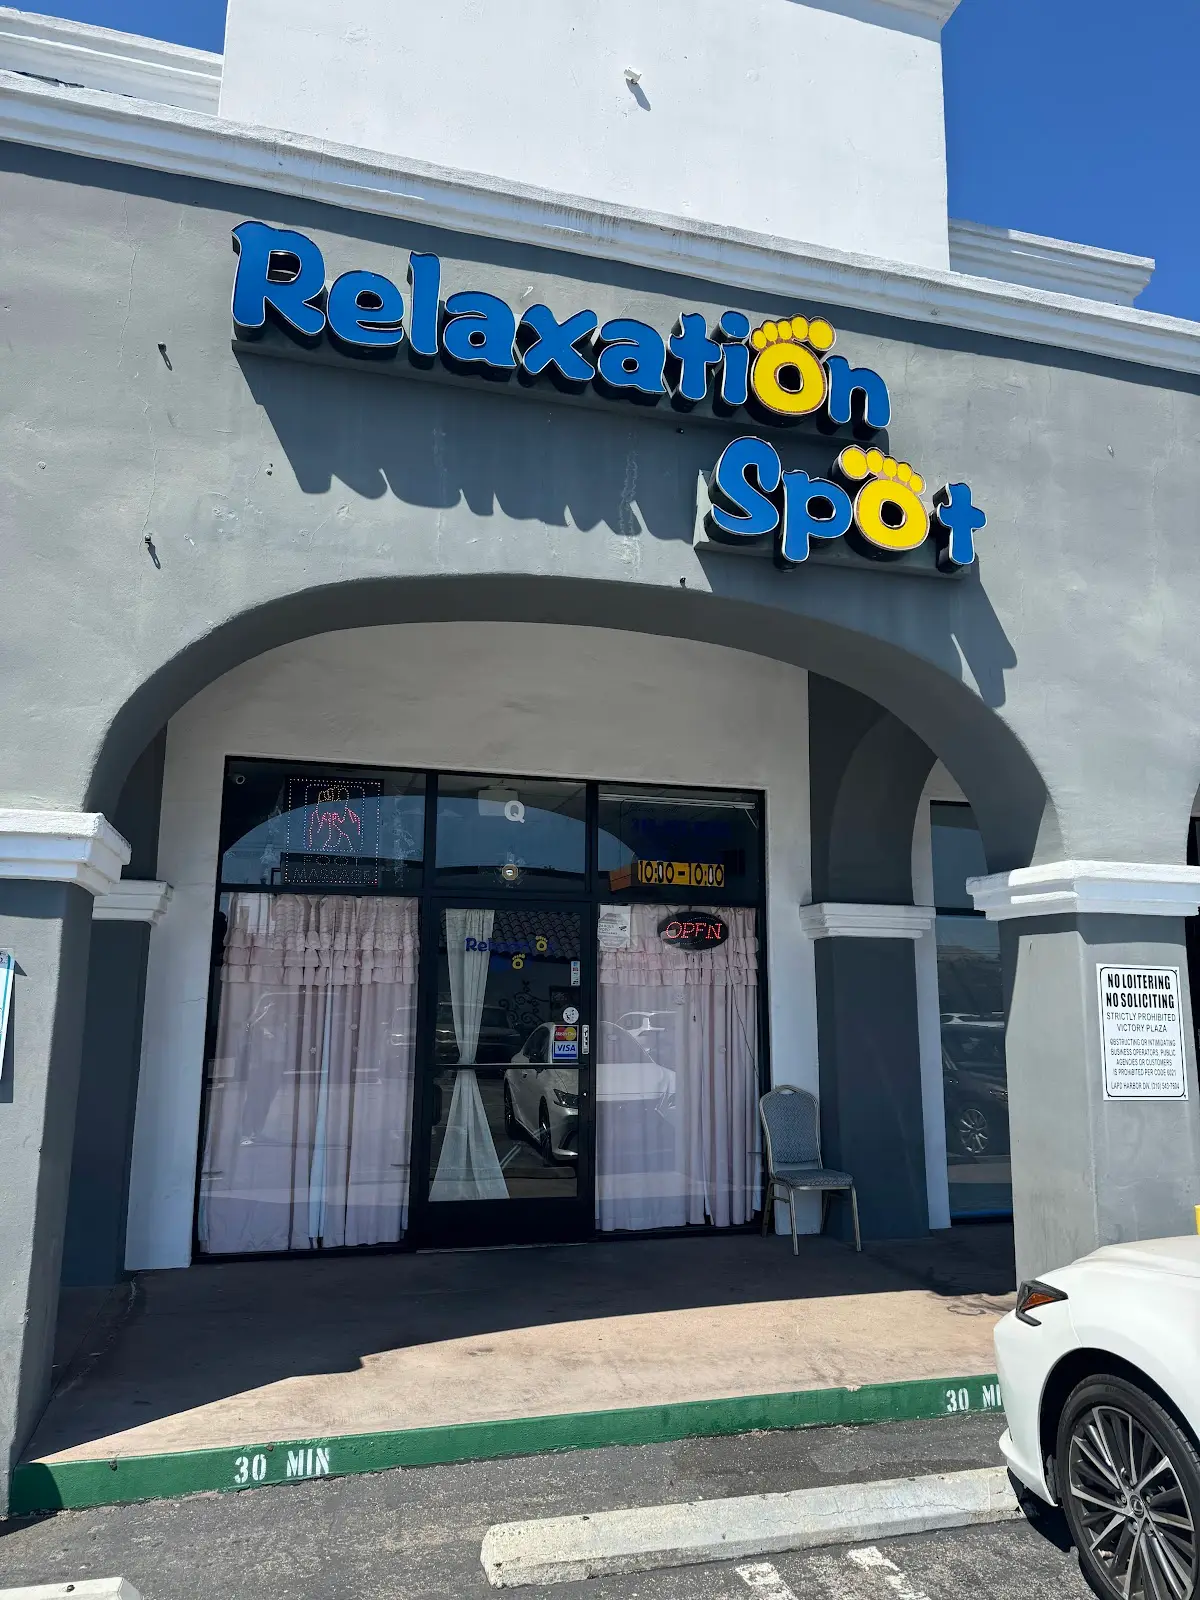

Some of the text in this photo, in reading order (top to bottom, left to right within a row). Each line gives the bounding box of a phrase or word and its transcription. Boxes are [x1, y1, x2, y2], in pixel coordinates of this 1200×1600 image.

[231, 220, 892, 429] Relaxation
[710, 436, 986, 567] Spot
[504, 800, 525, 823] Q
[303, 855, 362, 866] FOOT
[293, 867, 370, 880] MASSAGE
[1107, 973, 1171, 990] NO LOITERING
[1106, 992, 1175, 1009] NO SOLICITING
[1106, 1012, 1176, 1022] STRICTLY PROHIBITED
[1116, 1024, 1168, 1033] VICTORY PLAZA
[557, 1044, 576, 1052] VISA
[1110, 1048, 1132, 1056] BUSINESS
[1160, 1049, 1176, 1057] PUBLIC
[1116, 1058, 1172, 1066] AGENCIES OR CUSTOMERS
[1113, 1068, 1117, 1076] IS
[1118, 1068, 1144, 1076] PROHIBITED
[1144, 1068, 1153, 1076] PER
[1154, 1068, 1167, 1076] CODE
[1123, 1081, 1142, 1090] HARBOR
[945, 1384, 1002, 1412] 30 MI
[234, 1447, 330, 1483] 30 MIN
